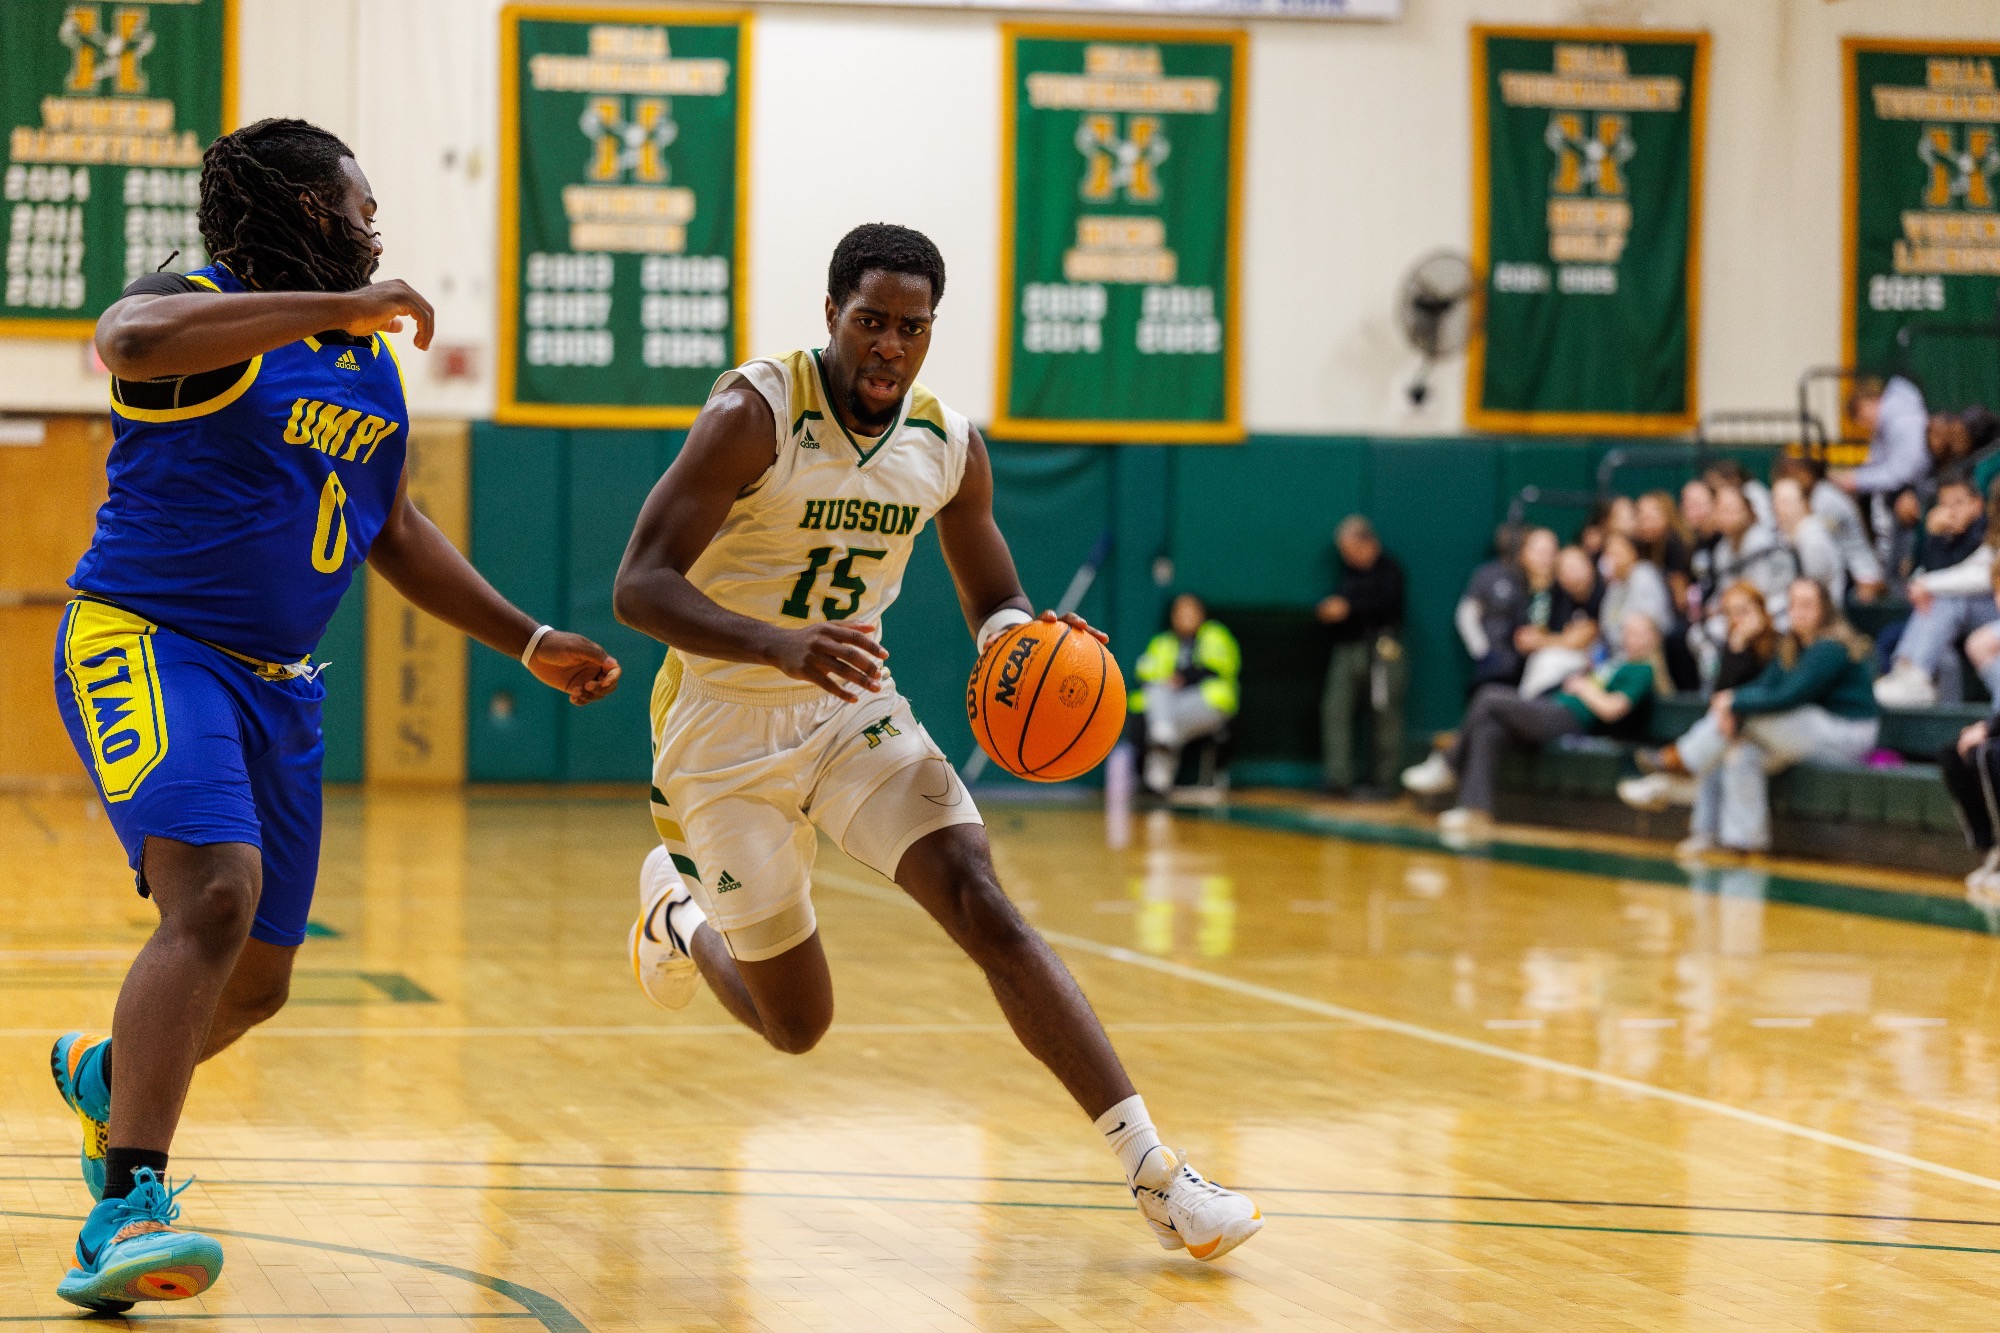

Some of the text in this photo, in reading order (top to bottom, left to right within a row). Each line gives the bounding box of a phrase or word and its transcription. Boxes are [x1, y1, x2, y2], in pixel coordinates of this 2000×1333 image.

[335, 361, 360, 371] adidas
[311, 471, 348, 574] 0
[799, 499, 920, 535] HUSSON
[780, 547, 889, 621] 15
[995, 637, 1040, 708] NCAA
[717, 881, 742, 893] adidas
